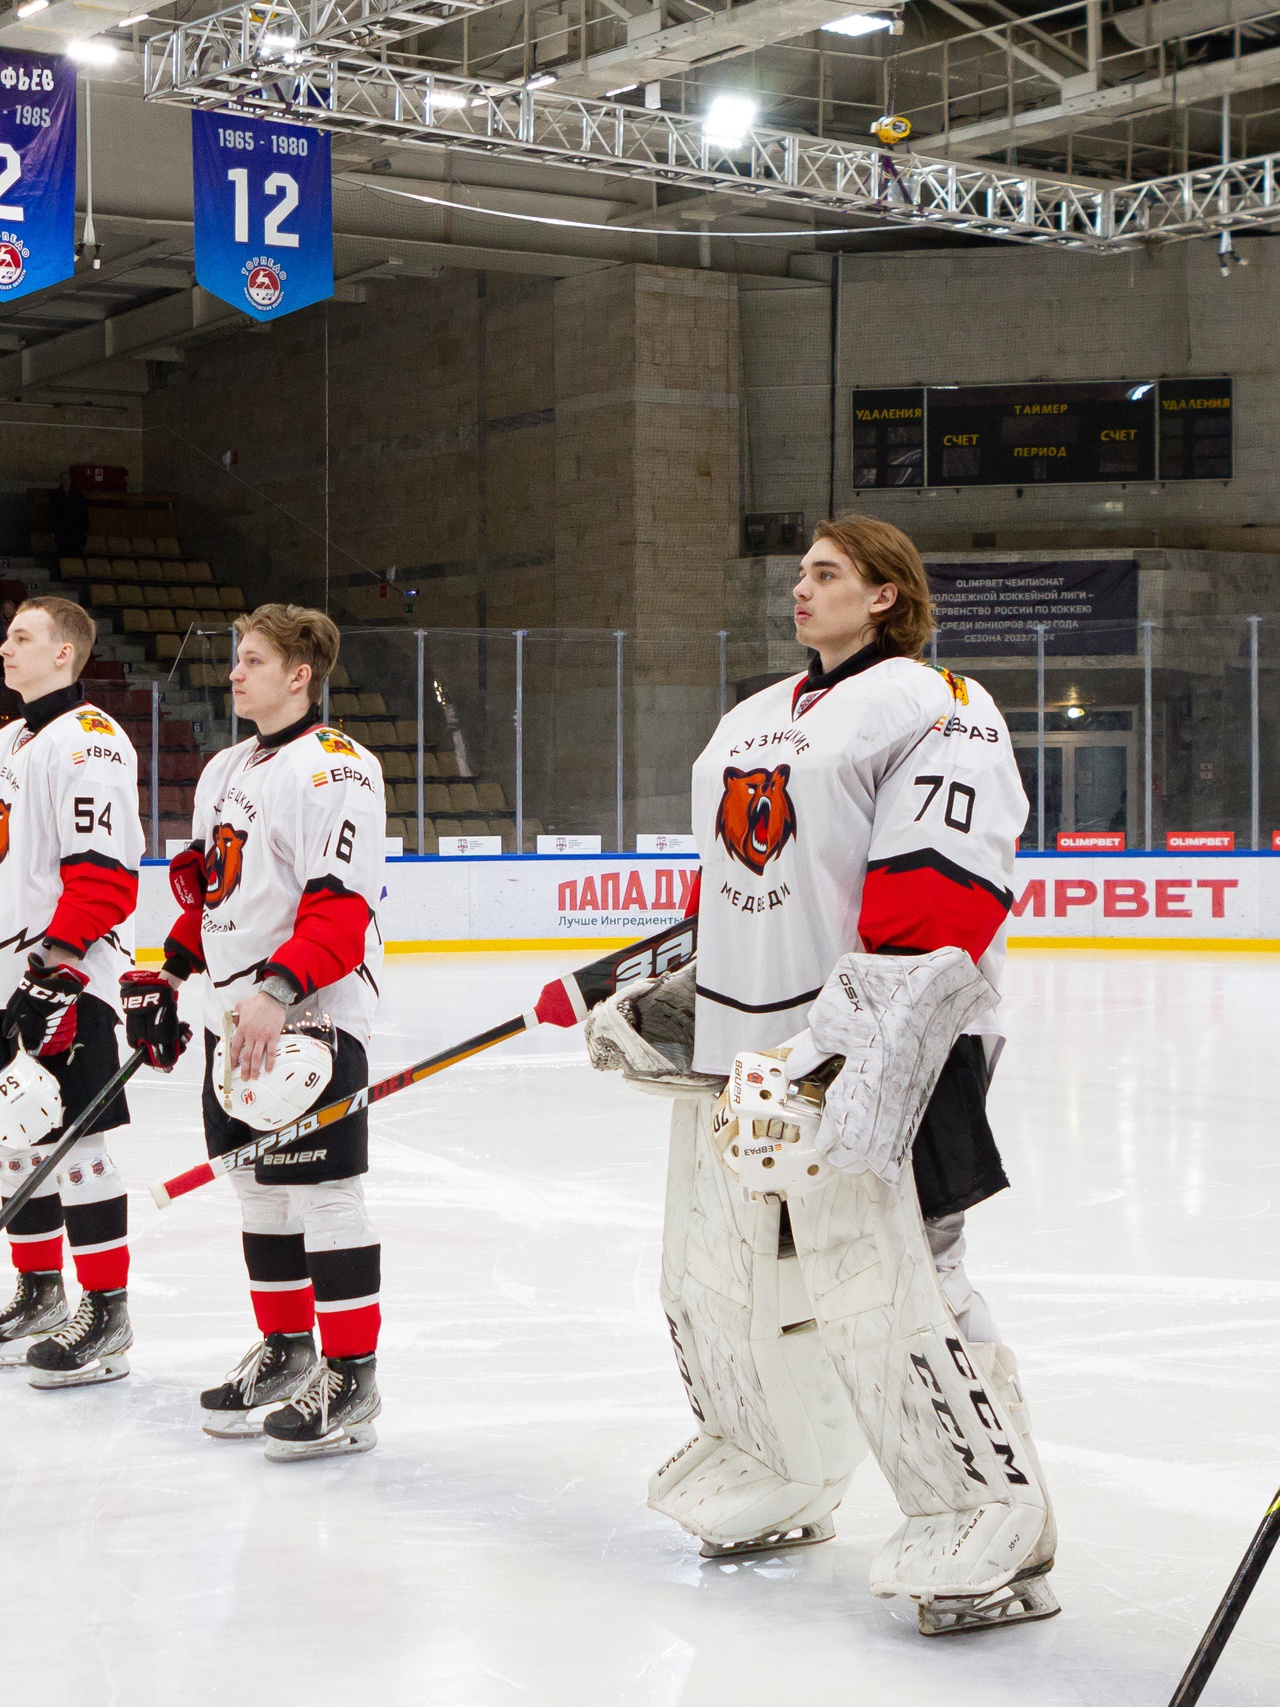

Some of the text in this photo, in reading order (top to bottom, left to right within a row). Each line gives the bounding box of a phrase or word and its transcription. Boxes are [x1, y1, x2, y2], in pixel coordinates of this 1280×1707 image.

[15, 104, 51, 128] 1985
[218, 128, 254, 151] 1965
[271, 135, 308, 156] 1980
[227, 168, 300, 247] 12
[241, 256, 287, 281] ТОРПЕДО
[1014, 403, 1068, 415] ТАЙМЕР
[1162, 397, 1231, 410] УДАЛЕНИЯ
[856, 407, 922, 420] УДАЛЕНИЯ
[943, 433, 980, 446] СЧЕТ
[1100, 429, 1138, 442] СЧЕТ
[1014, 446, 1067, 458] ПЕРИОД
[956, 577, 1064, 588] OLIMPBET ЧЕМПИОНАТ
[999, 589, 1058, 601] ХОККЕЙНОЙ
[1059, 591, 1086, 600] ЛИГИ
[994, 606, 1033, 615] РОССИИ
[1034, 605, 1048, 614] ПО
[1050, 604, 1092, 614] ХОККЕЮ
[940, 621, 972, 631] СРЕДИ
[974, 620, 1023, 630] ЮНИОРОВ
[1053, 620, 1079, 629] ГОДА
[964, 633, 1055, 643] СЕЗОНА 2023/224
[194, 722, 200, 732] 6
[913, 775, 976, 834] 70
[74, 797, 112, 836] 54
[323, 819, 356, 864] 16
[1060, 837, 1121, 847] OLIMPBET
[1170, 837, 1230, 846] OLIMPBET
[558, 870, 649, 911] ПАПА
[720, 881, 791, 914] МЕДВЕДИ
[558, 915, 598, 928] Лучше
[19, 977, 77, 1006] CCM
[839, 973, 863, 1013] GSX
[734, 1059, 743, 1105] BAUER
[744, 1144, 774, 1156] ЕВРАЗ
[263, 1149, 327, 1165] BAUER
[945, 1337, 1030, 1486] CCM
[910, 1352, 988, 1486] CCM
